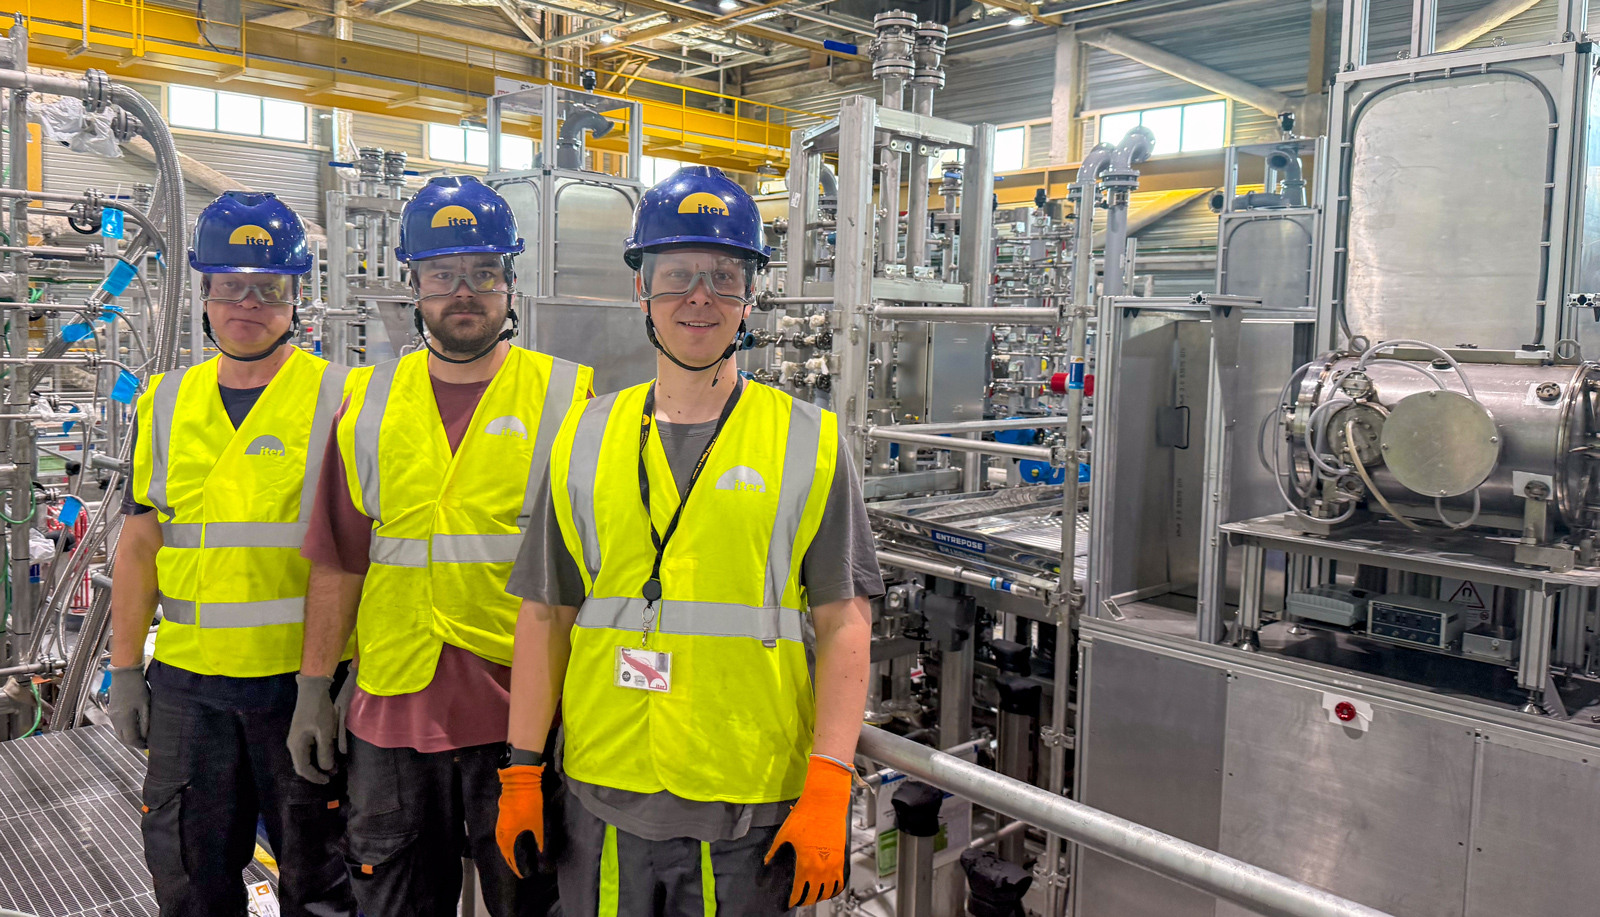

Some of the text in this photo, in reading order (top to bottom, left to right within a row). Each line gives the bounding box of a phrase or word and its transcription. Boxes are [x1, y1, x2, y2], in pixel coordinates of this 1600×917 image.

[698, 203, 725, 216] iter
[447, 216, 473, 227] iter
[245, 235, 270, 246] iter
[501, 426, 526, 440] iter
[260, 446, 284, 457] iter
[734, 479, 762, 493] iter
[935, 531, 983, 551] ENTREPOSE
